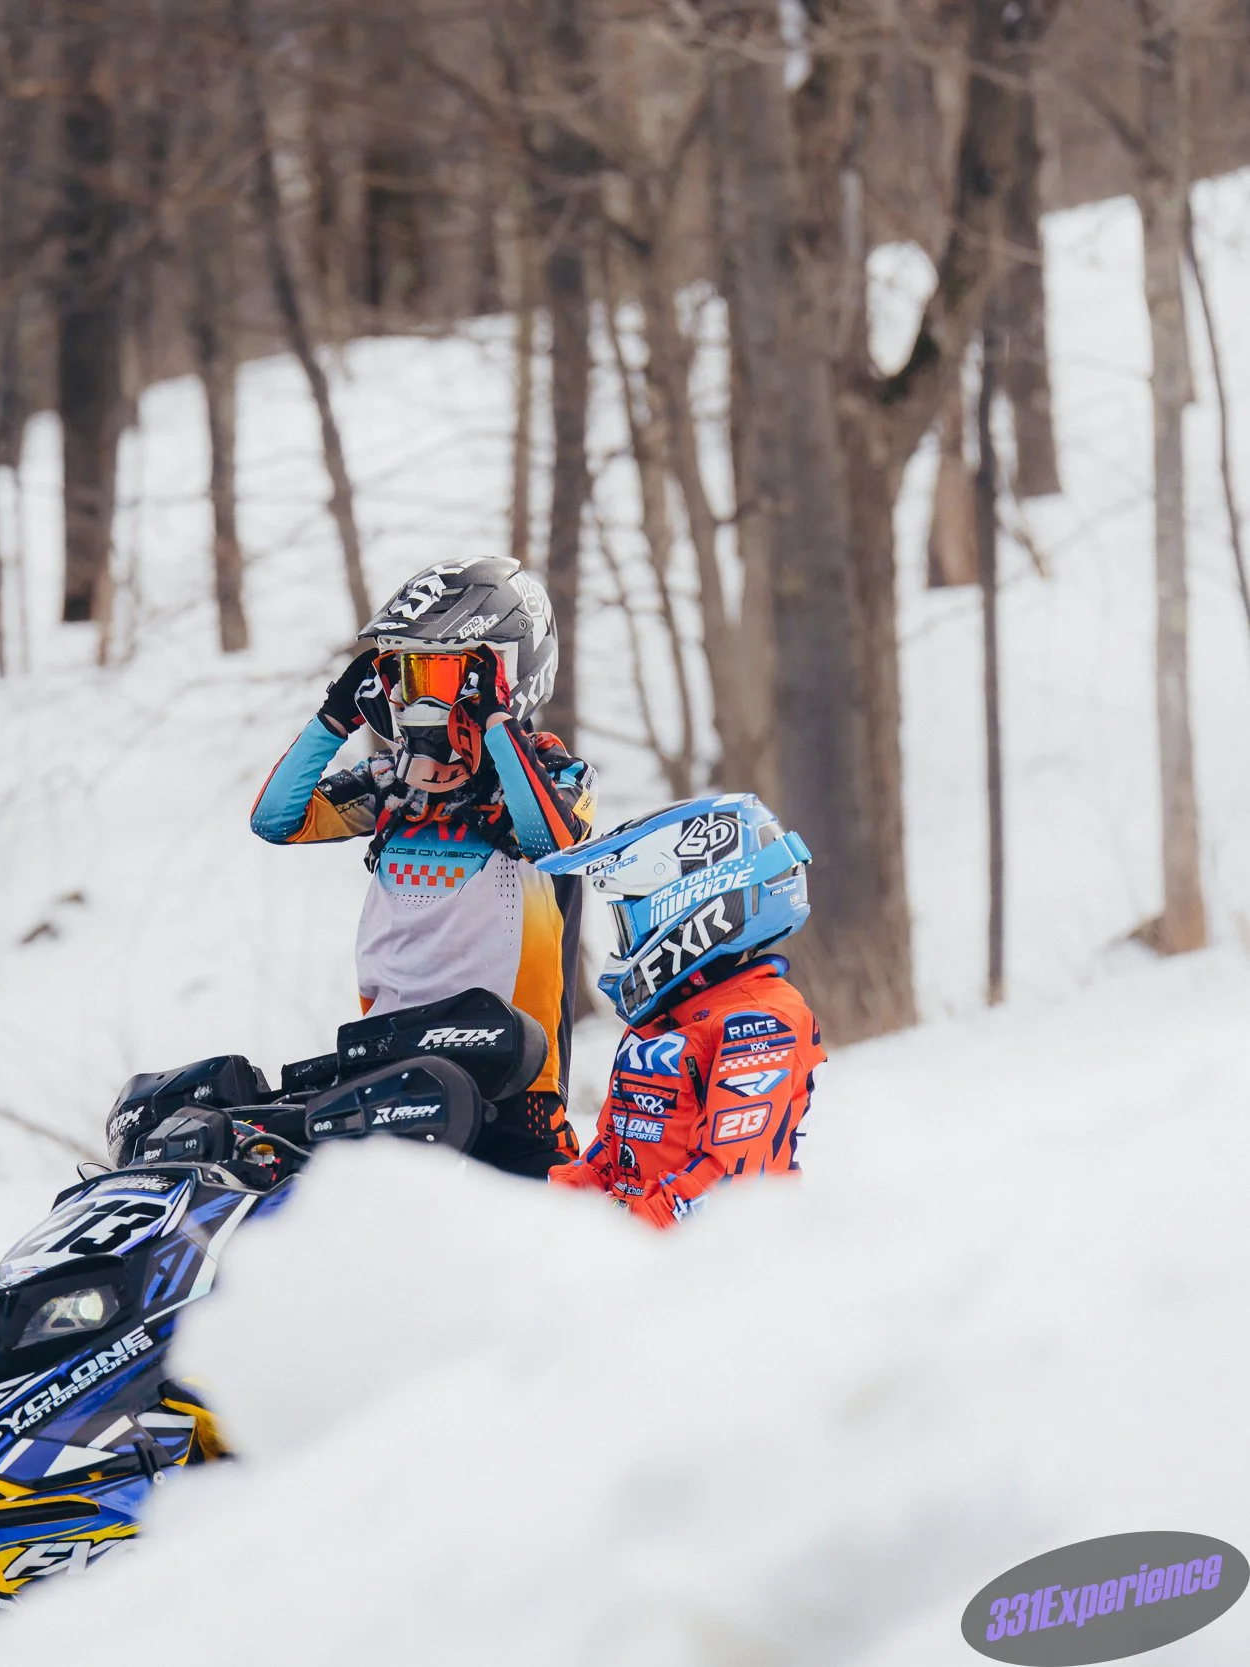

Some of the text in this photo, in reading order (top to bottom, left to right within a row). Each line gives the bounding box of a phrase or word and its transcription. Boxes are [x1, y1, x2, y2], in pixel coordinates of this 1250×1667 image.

[458, 616, 483, 639] PRO
[419, 849, 488, 860] DIVISION
[589, 854, 620, 874] PRO
[651, 864, 725, 905] FACTORY
[639, 896, 733, 995] FXR
[417, 1027, 505, 1047] ROX
[728, 1019, 778, 1040] RACE
[424, 1041, 497, 1051] SPEEDFX
[718, 1107, 767, 1139] 213
[14, 1338, 154, 1435] MOTORSPORTS
